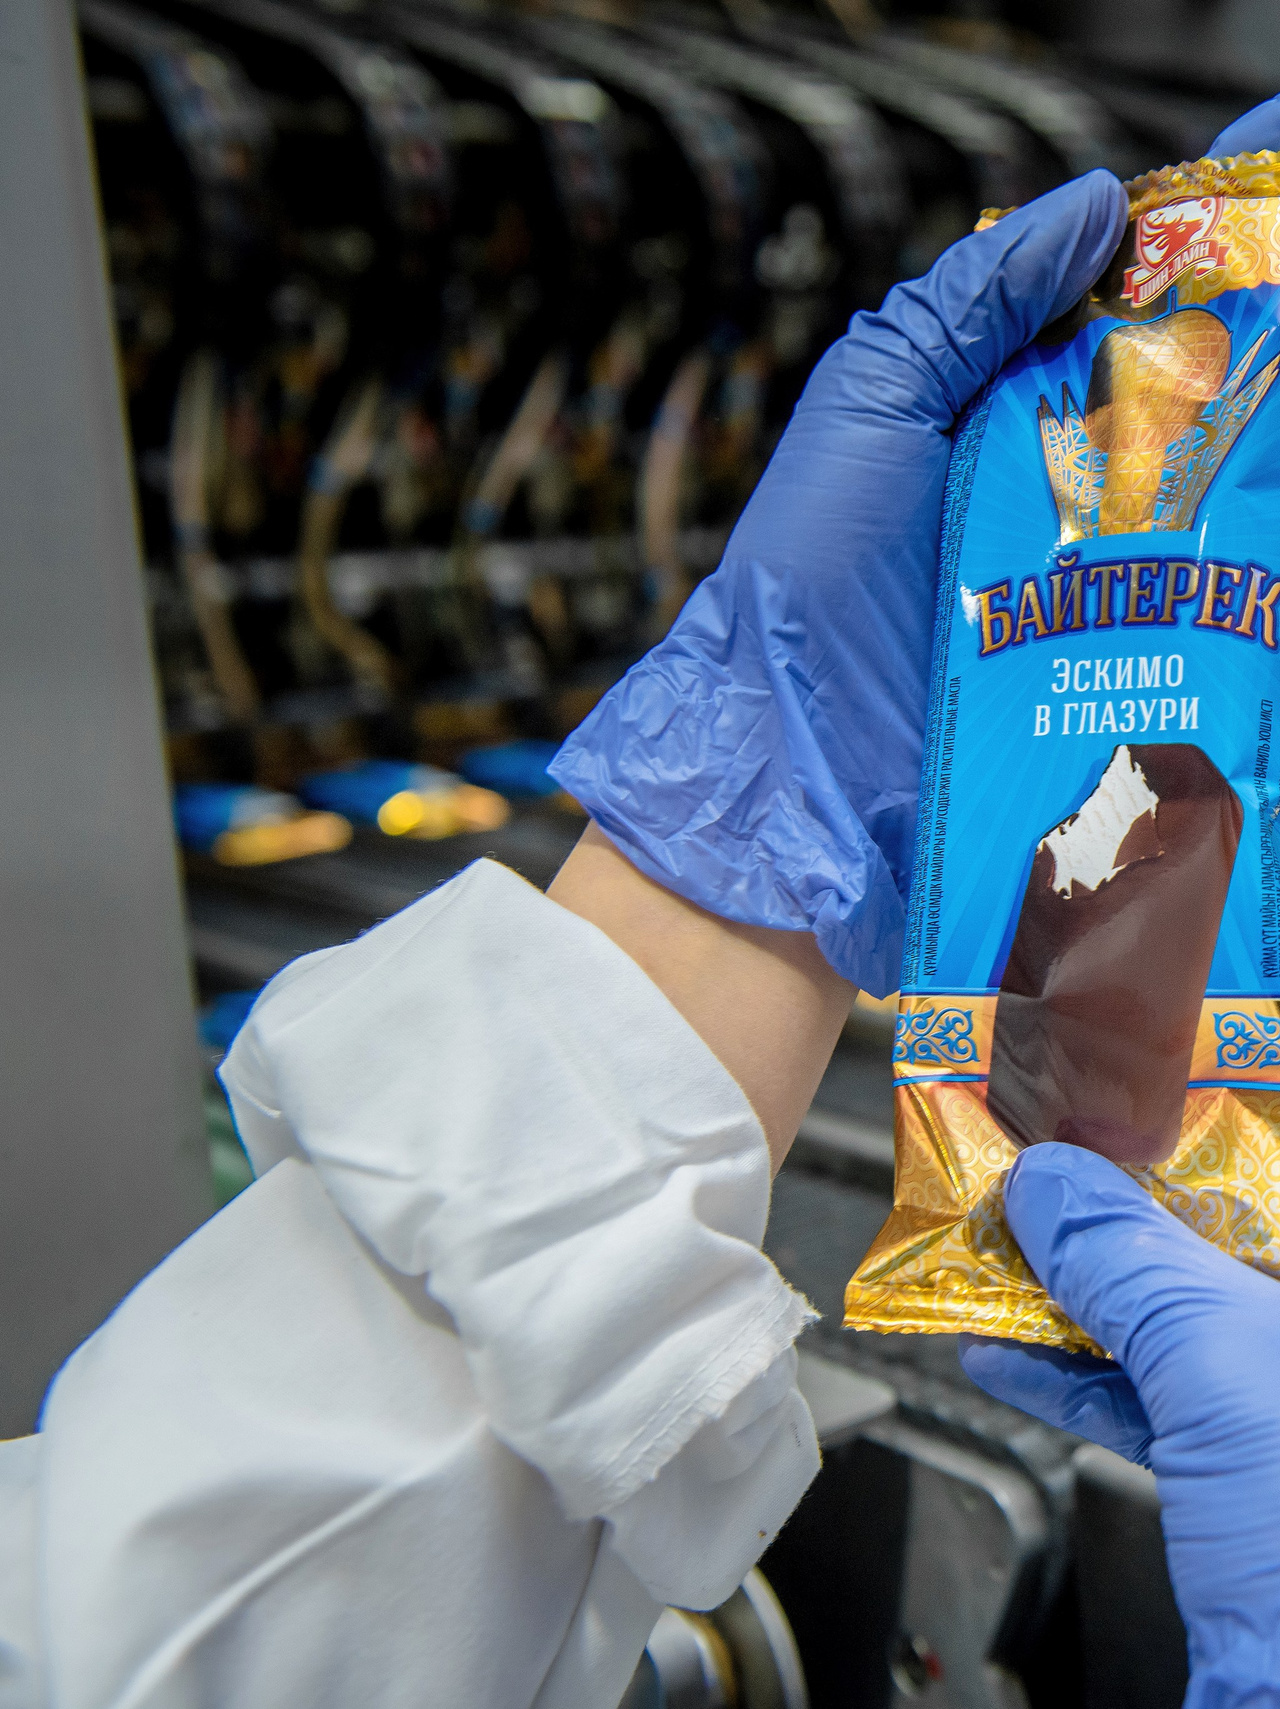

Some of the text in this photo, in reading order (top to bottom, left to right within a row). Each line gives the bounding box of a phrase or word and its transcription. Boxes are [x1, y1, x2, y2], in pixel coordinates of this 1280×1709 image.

[1138, 241, 1211, 300] ШИН-ЛАЙН
[947, 676, 962, 706] МАСЛА
[1051, 654, 1185, 693] ЭСКИМО
[1033, 697, 1200, 736] В ГЛАЗУРИ
[1258, 721, 1272, 743] ХОШ
[940, 707, 959, 771] РАСТИТЕЛЬНЫЕ
[1253, 743, 1270, 778] ВАНИЛЬ
[934, 772, 952, 836] БАР/СОДЕРЖИТ
[930, 838, 946, 882] МАЙЛАРЫ
[928, 883, 944, 919] ӨСІМДІК
[1259, 893, 1277, 927] МАЙЫН
